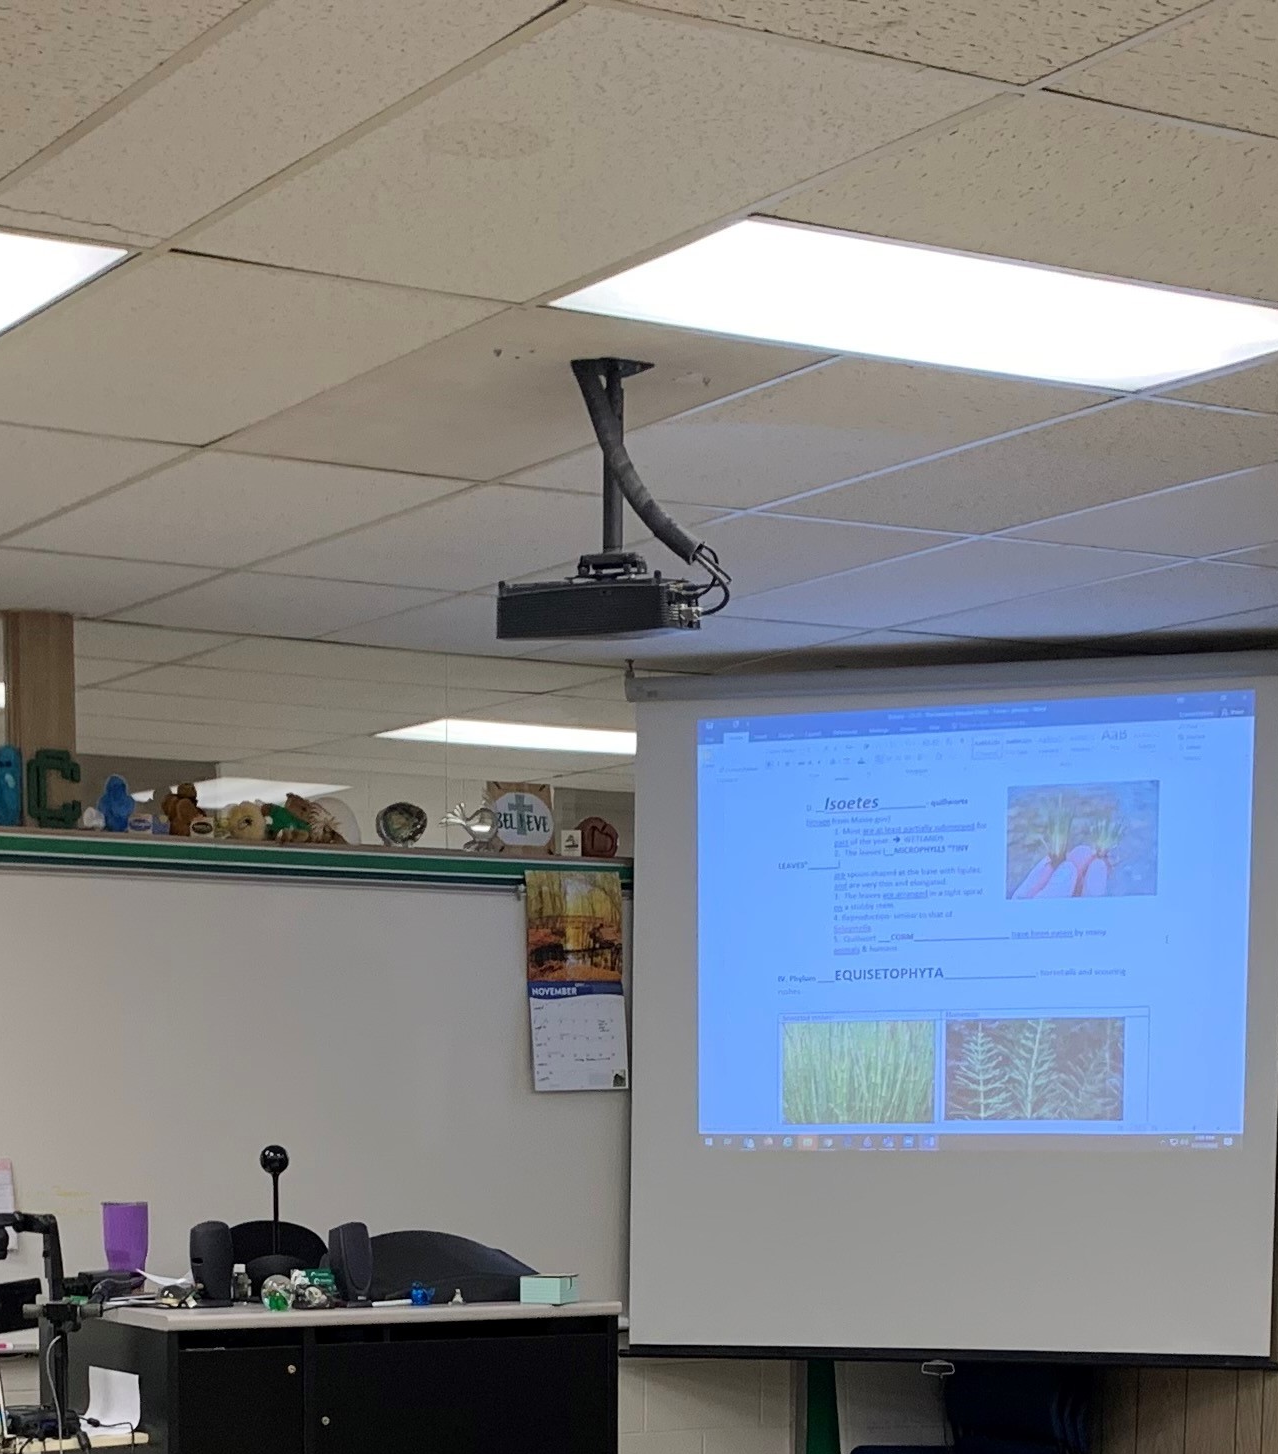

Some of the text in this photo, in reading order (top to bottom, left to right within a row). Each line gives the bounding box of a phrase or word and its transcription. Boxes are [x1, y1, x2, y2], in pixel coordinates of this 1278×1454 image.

[824, 796, 880, 812] Isoetes
[834, 967, 944, 982] EQUISETOPHYTA
[531, 986, 577, 996] NOVEMBER
